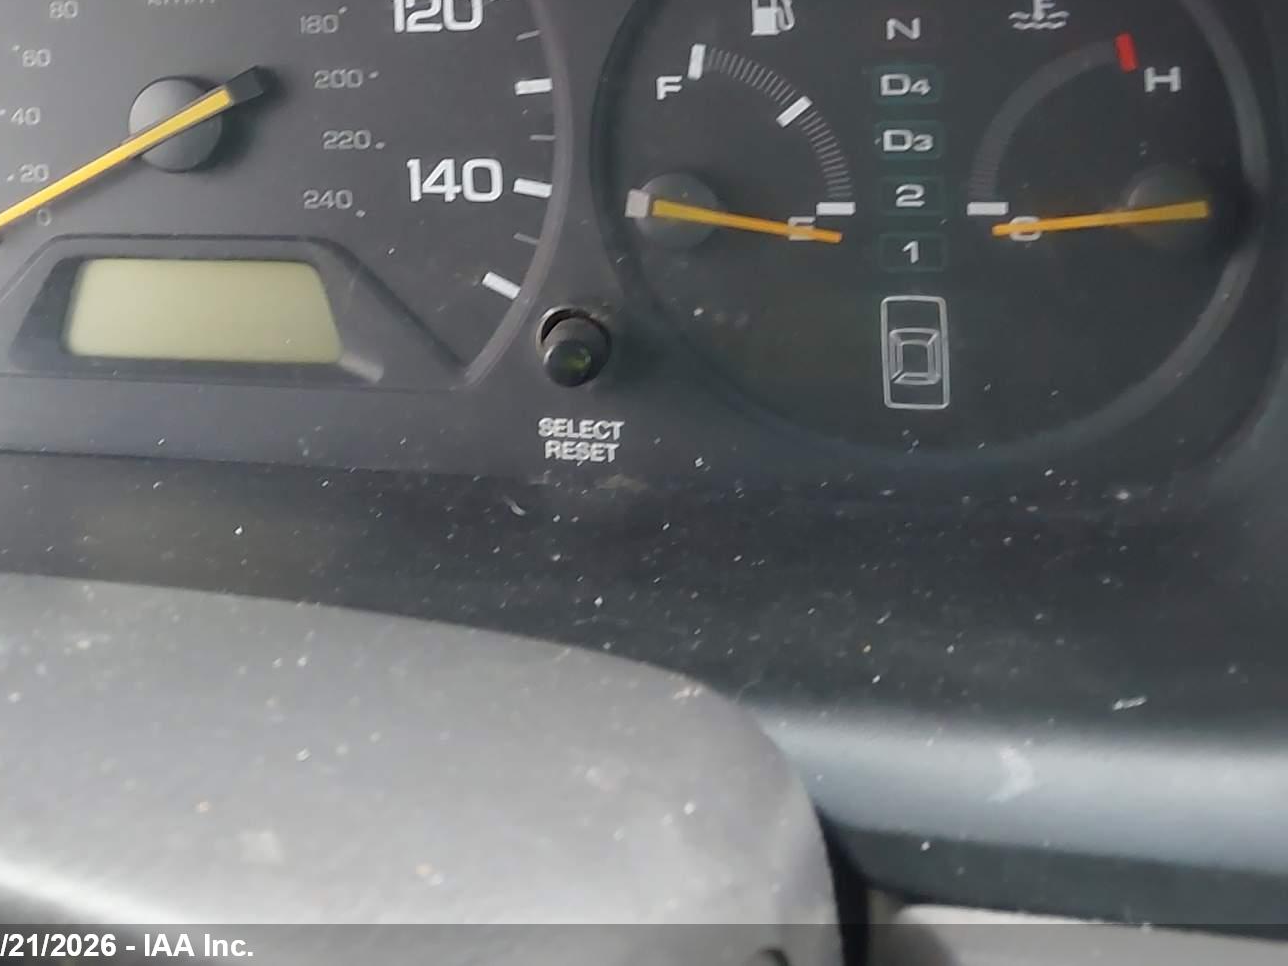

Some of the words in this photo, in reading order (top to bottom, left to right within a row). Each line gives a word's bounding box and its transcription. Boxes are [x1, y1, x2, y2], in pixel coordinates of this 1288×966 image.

[49, 0, 78, 19] 80
[300, 13, 339, 34] 180
[886, 18, 921, 40] N
[22, 49, 51, 68] 60
[314, 69, 363, 89] 200
[656, 76, 682, 100] F
[880, 74, 931, 97] D4
[1144, 67, 1182, 92] H
[11, 107, 40, 126] 40
[322, 130, 371, 150] 220
[882, 129, 934, 152] D3
[19, 164, 49, 183] 20
[406, 158, 503, 203] 140
[303, 190, 353, 210] 240
[895, 184, 926, 209] 2
[36, 209, 52, 227] 0
[903, 242, 919, 264] 1
[538, 417, 625, 440] SELECT
[545, 440, 620, 463] RESET
